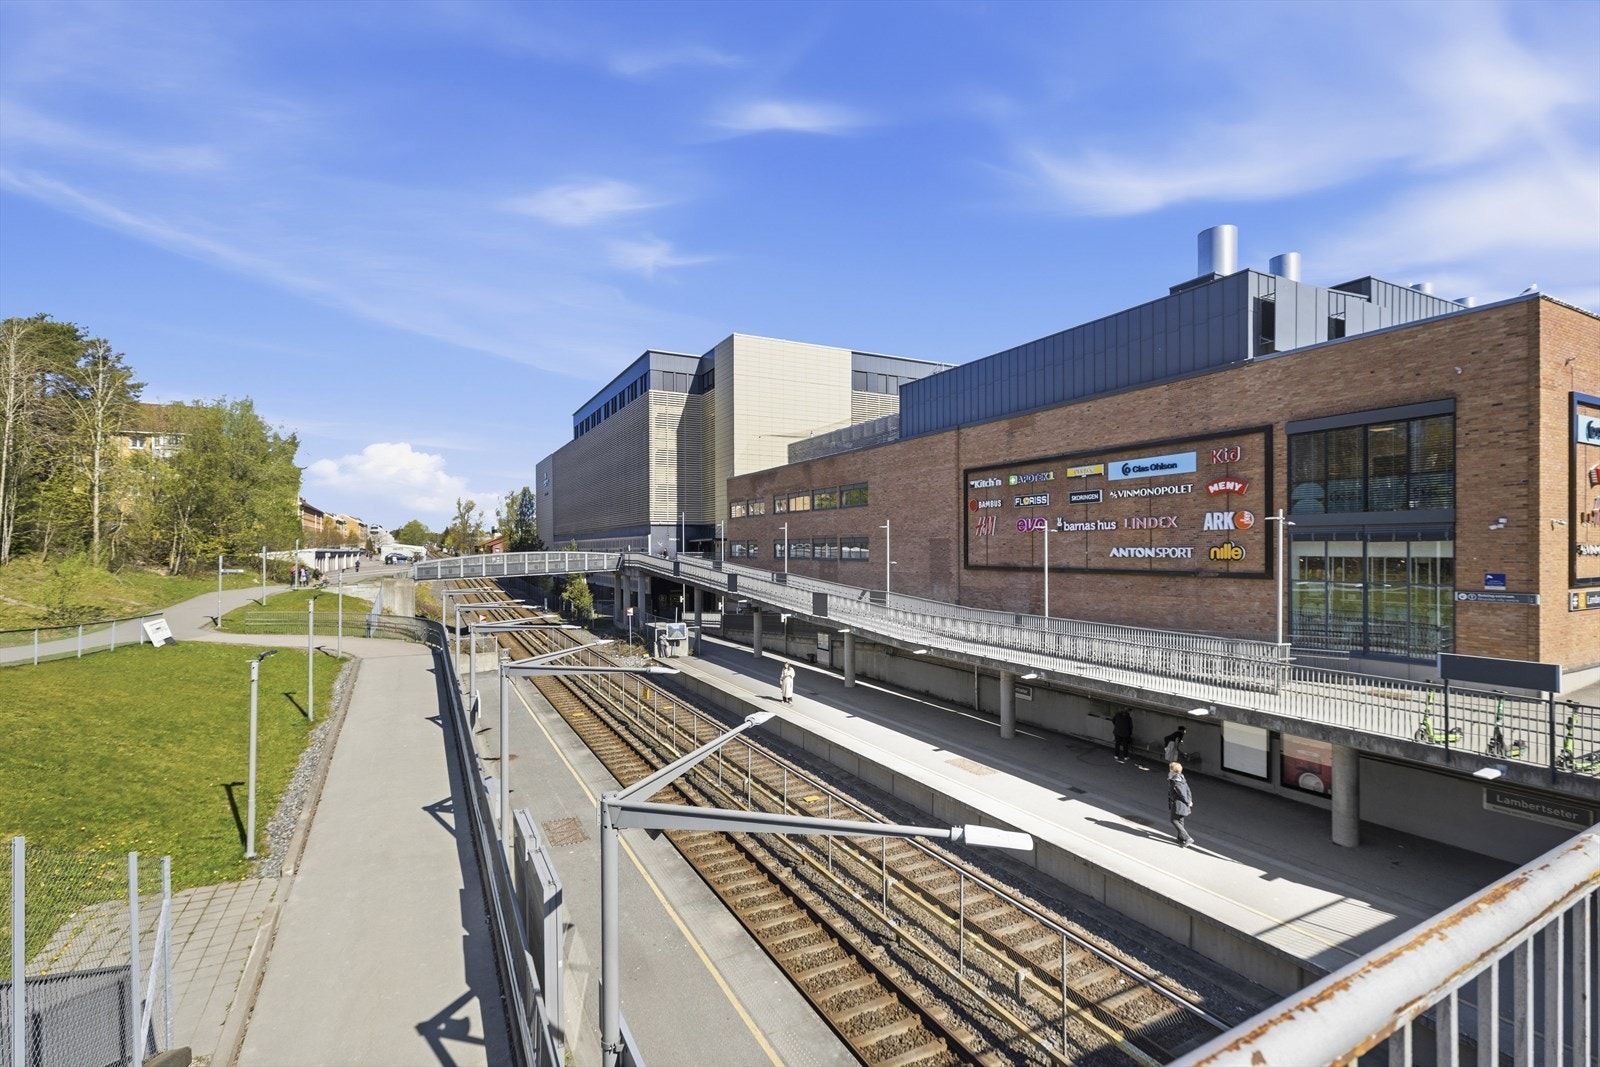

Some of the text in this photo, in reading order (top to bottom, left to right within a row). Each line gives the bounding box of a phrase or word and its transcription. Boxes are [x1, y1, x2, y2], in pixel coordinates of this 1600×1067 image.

[1211, 446, 1241, 464] Kid
[1150, 462, 1178, 471] Ohlson
[1118, 484, 1193, 498] VINMONOPOLET
[1208, 481, 1243, 493] MENY
[978, 499, 1002, 508] BAMBUS
[1015, 495, 1047, 506] FLORISS
[975, 515, 997, 536] H&M
[1063, 519, 1117, 531] barnas hus
[1124, 516, 1178, 530] LINDEX
[1203, 511, 1236, 530] ARK
[1209, 541, 1245, 560] nille
[1496, 794, 1579, 820] Lambertseter
